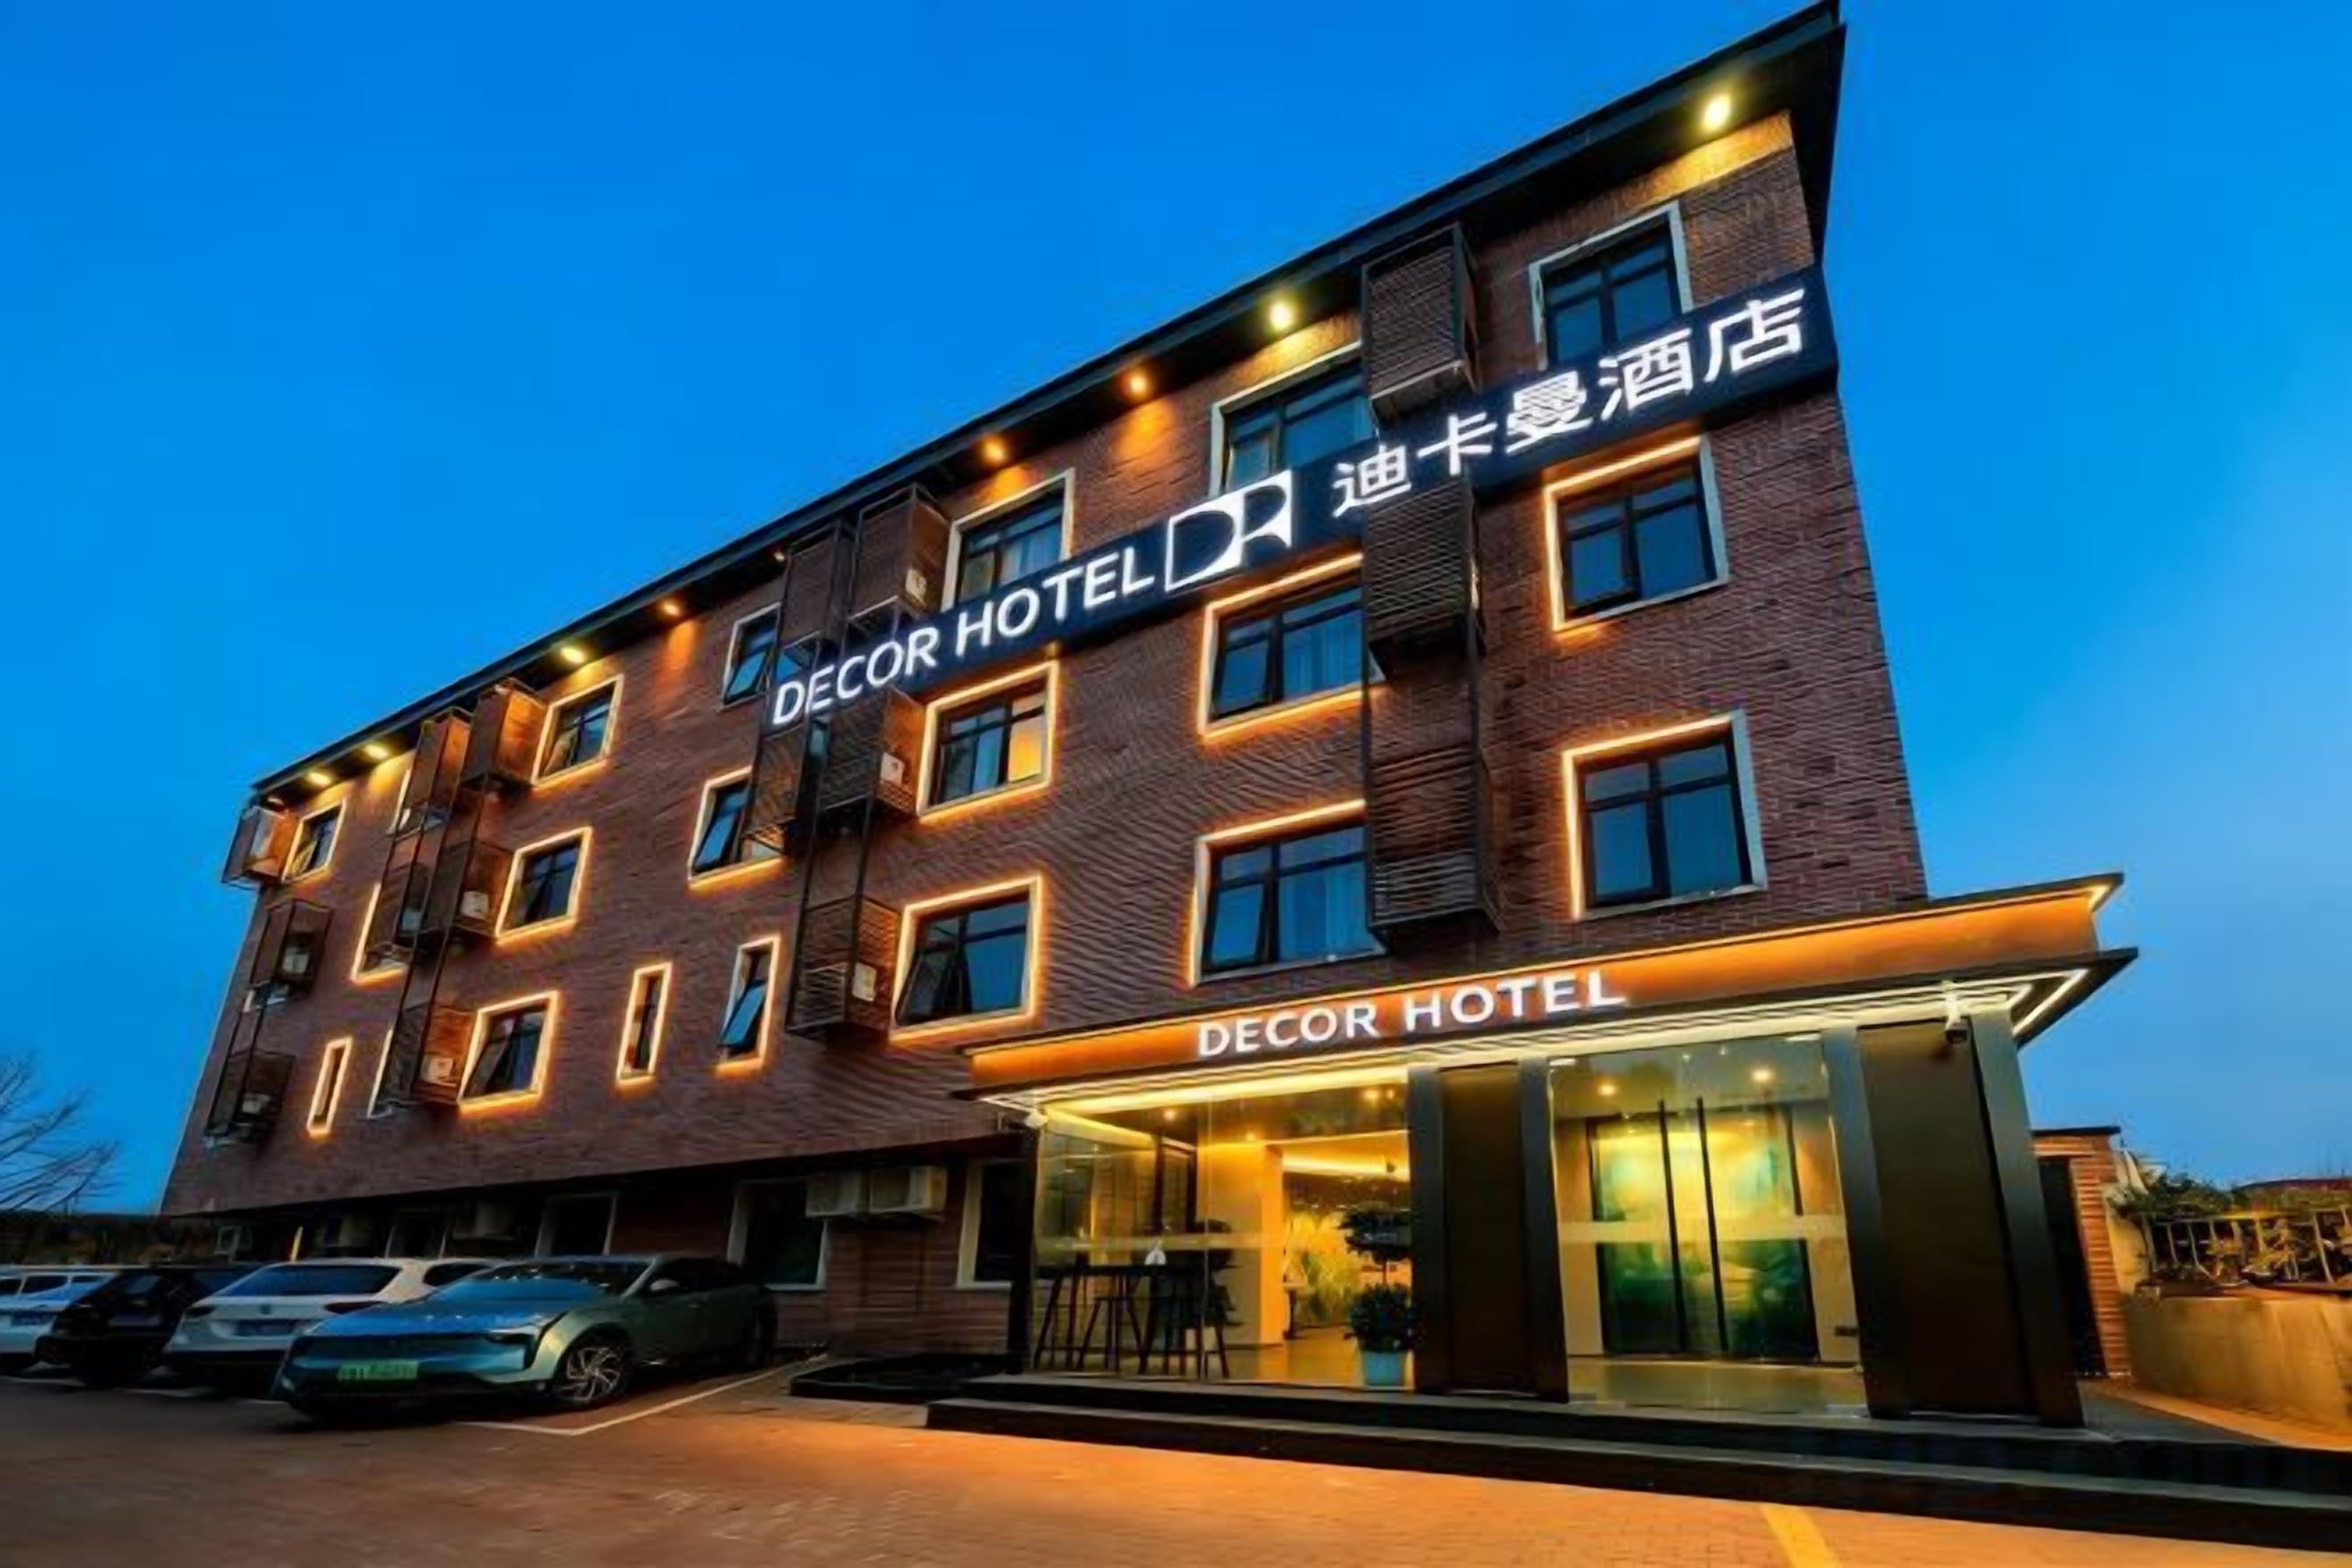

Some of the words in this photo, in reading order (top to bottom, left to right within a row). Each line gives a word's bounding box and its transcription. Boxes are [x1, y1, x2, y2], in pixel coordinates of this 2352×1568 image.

[1332, 288, 1805, 517] 迪卡曼酒店
[772, 626, 941, 725] DECOR
[956, 547, 1156, 657] HOTEL
[1198, 1005, 1379, 1057] DECOR
[1403, 969, 1626, 1032] HOTEL
